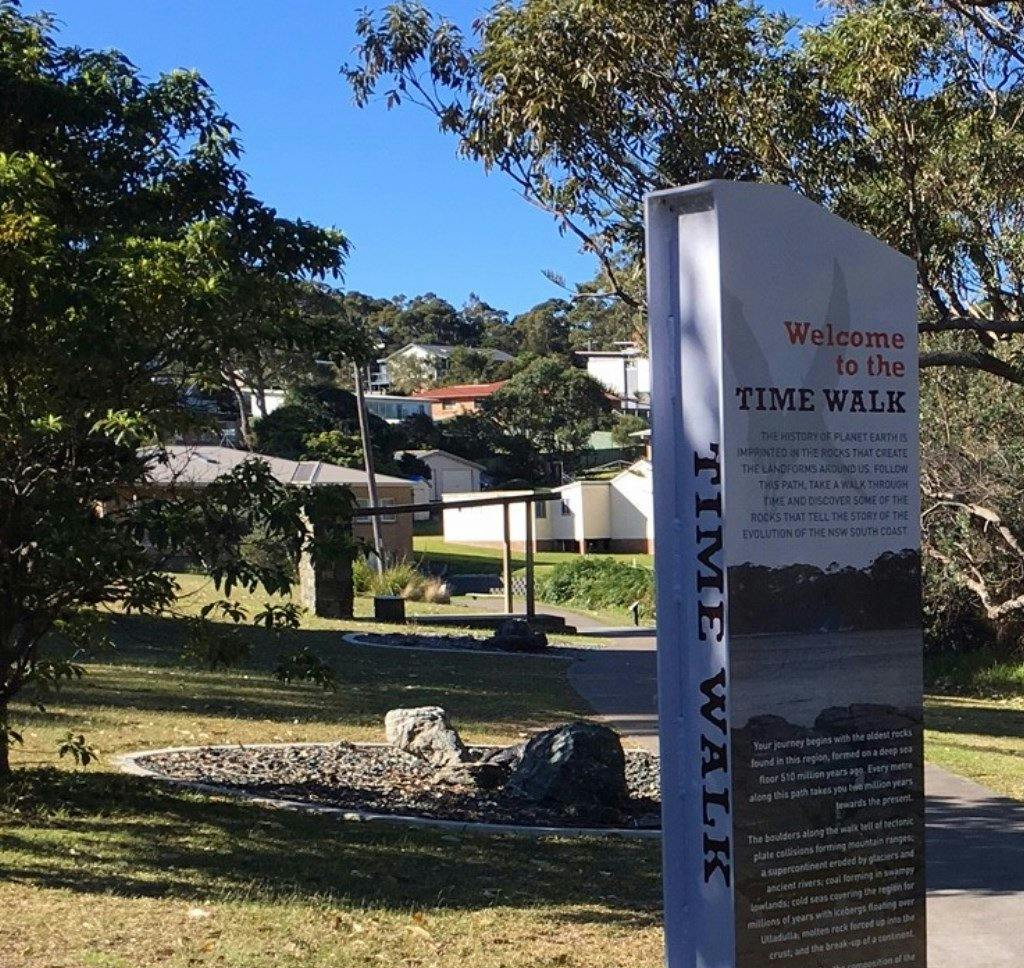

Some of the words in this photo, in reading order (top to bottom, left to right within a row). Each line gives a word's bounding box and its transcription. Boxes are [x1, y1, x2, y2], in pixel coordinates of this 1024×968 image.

[784, 321, 905, 349] Welcome
[836, 355, 858, 376] to
[867, 355, 905, 377] the
[736, 388, 815, 411] TIME
[822, 389, 905, 413] WALK
[761, 432, 778, 441] THE
[781, 432, 817, 442] HISTORY
[821, 433, 831, 442] OF
[834, 433, 867, 442] PLANET
[870, 433, 898, 442] EARTH
[900, 433, 908, 442] IS
[737, 449, 787, 458] IMPRINTED
[791, 449, 799, 458] IN
[801, 449, 817, 458] THE
[821, 449, 849, 458] ROCKS
[852, 449, 872, 458] THAT
[876, 449, 908, 458] CREATE
[742, 464, 759, 473] THE
[762, 464, 817, 473] LANDFORMS
[820, 465, 855, 473] AROUND
[874, 464, 908, 473] FOLLOW
[759, 481, 779, 490] THIS
[809, 481, 830, 489] TAKE
[841, 481, 865, 489] WALK
[868, 481, 908, 489] THROUGH
[764, 497, 785, 506] TIME
[788, 497, 805, 506] AND
[808, 496, 850, 506] DISCOVER
[853, 496, 876, 505] SOME
[879, 496, 890, 505] OF
[893, 496, 908, 505] THE
[751, 513, 781, 522] ROCKS
[783, 513, 805, 522] THAT
[808, 512, 829, 522] TELL
[832, 512, 848, 521] THE
[851, 512, 877, 521] STORY
[879, 512, 890, 520] OF
[893, 511, 908, 520] THE
[742, 529, 792, 539] EVOLUTION
[795, 529, 806, 538] OF
[810, 528, 825, 538] THE
[828, 528, 847, 538] NSW
[850, 527, 878, 537] SOUTH
[694, 442, 724, 642] TIME
[753, 741, 771, 750] Your
[773, 739, 804, 750] journey
[805, 736, 832, 746] begins
[833, 733, 850, 743] with
[851, 733, 865, 741] the
[866, 731, 889, 740] oldest
[891, 728, 912, 738] rocks
[751, 757, 774, 767] found
[785, 755, 800, 764] this
[832, 749, 859, 760] formed
[699, 667, 730, 888] WALK
[759, 775, 778, 784] floor
[797, 771, 824, 780] million
[826, 769, 848, 779] years
[868, 765, 888, 773] Every
[749, 793, 771, 802] along
[773, 790, 788, 799] this
[790, 787, 808, 799] path
[809, 786, 831, 795] takes
[833, 785, 846, 794] you
[868, 797, 881, 806] the
[748, 834, 763, 844] The
[765, 831, 800, 842] boulders
[802, 828, 824, 837] along
[825, 826, 838, 835] the
[753, 851, 774, 862] plate
